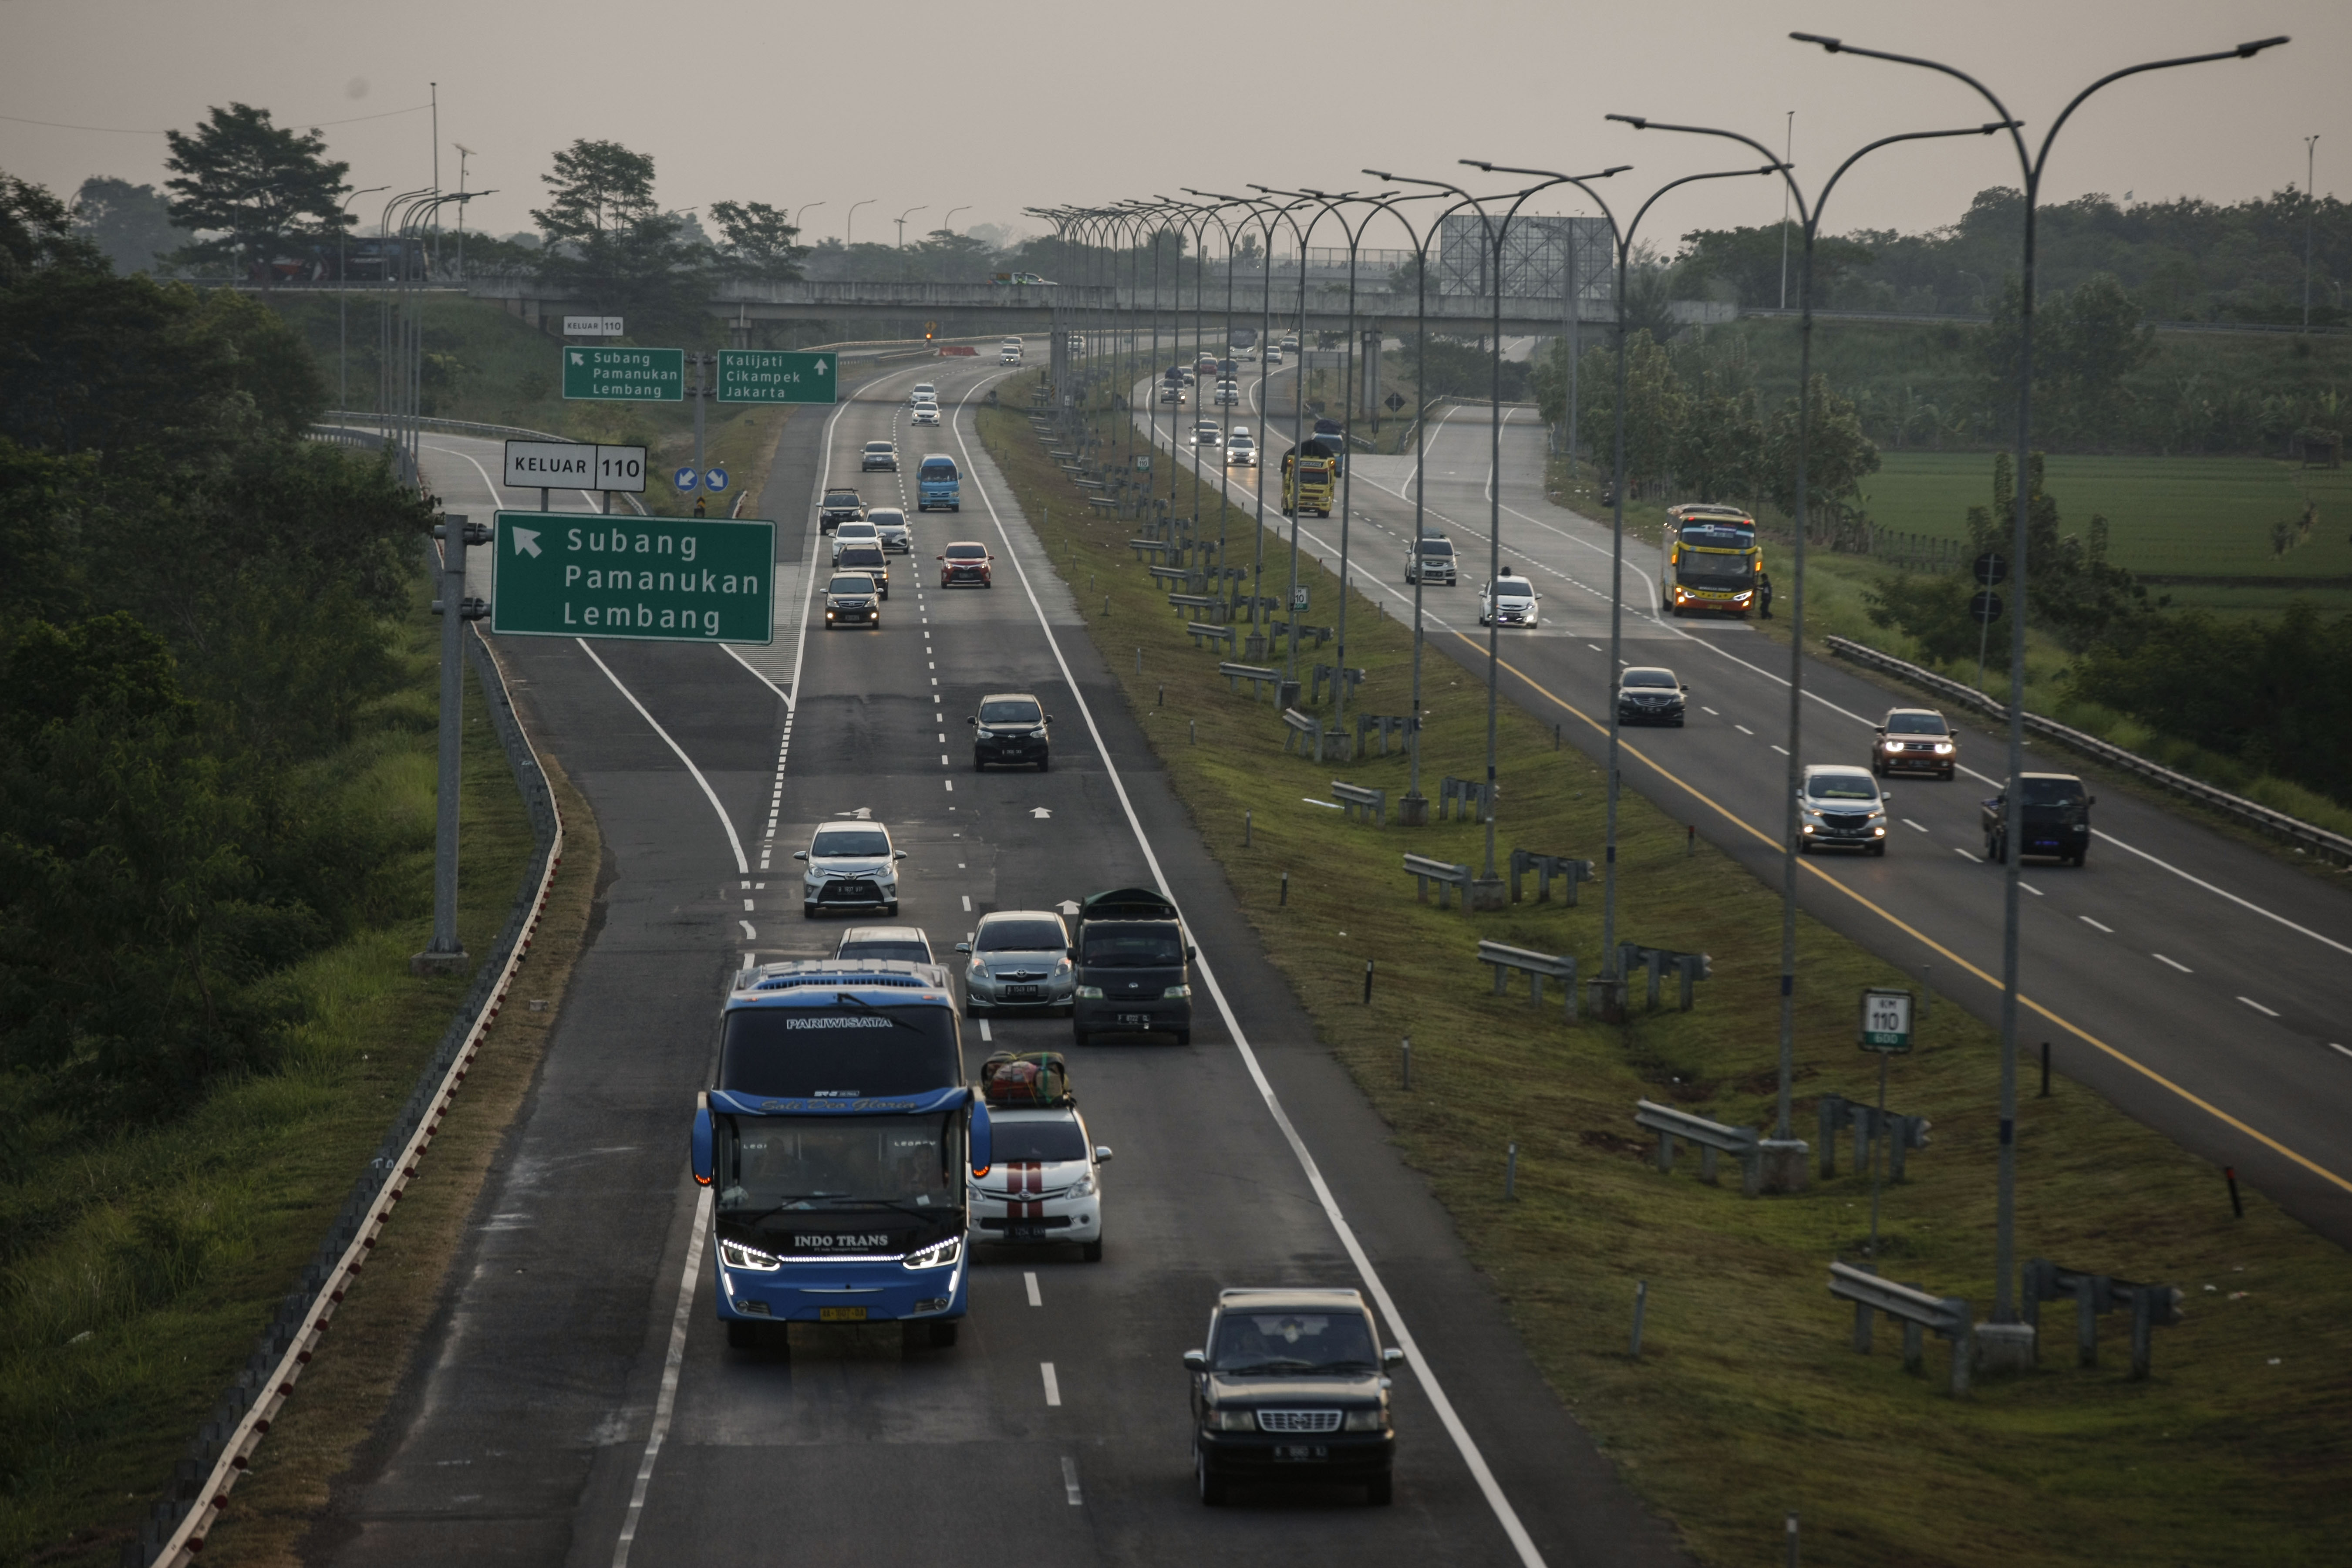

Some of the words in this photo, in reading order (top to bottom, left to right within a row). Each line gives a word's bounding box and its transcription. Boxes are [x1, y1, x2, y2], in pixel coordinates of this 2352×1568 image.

[594, 353, 650, 366] Subang
[727, 355, 782, 369] Kalijati
[593, 368, 677, 380] Pamanukan
[727, 371, 800, 384] Cikampek
[593, 384, 661, 398] Lembang
[727, 386, 785, 398] Jakarta
[515, 457, 586, 473] KELUAR
[602, 459, 640, 477] 110
[567, 528, 697, 561] Subang
[565, 565, 758, 594] Pamanukan
[1295, 594, 1304, 603] 10
[564, 602, 720, 636] Lembang
[1880, 1000, 1897, 1008] KM
[786, 1017, 893, 1029] PARIWISATA
[1874, 1013, 1899, 1030] 110
[807, 1099, 846, 1110] Deo
[852, 1098, 917, 1111] Gloria
[794, 1235, 833, 1247] INDO
[836, 1234, 888, 1247] TRANS
